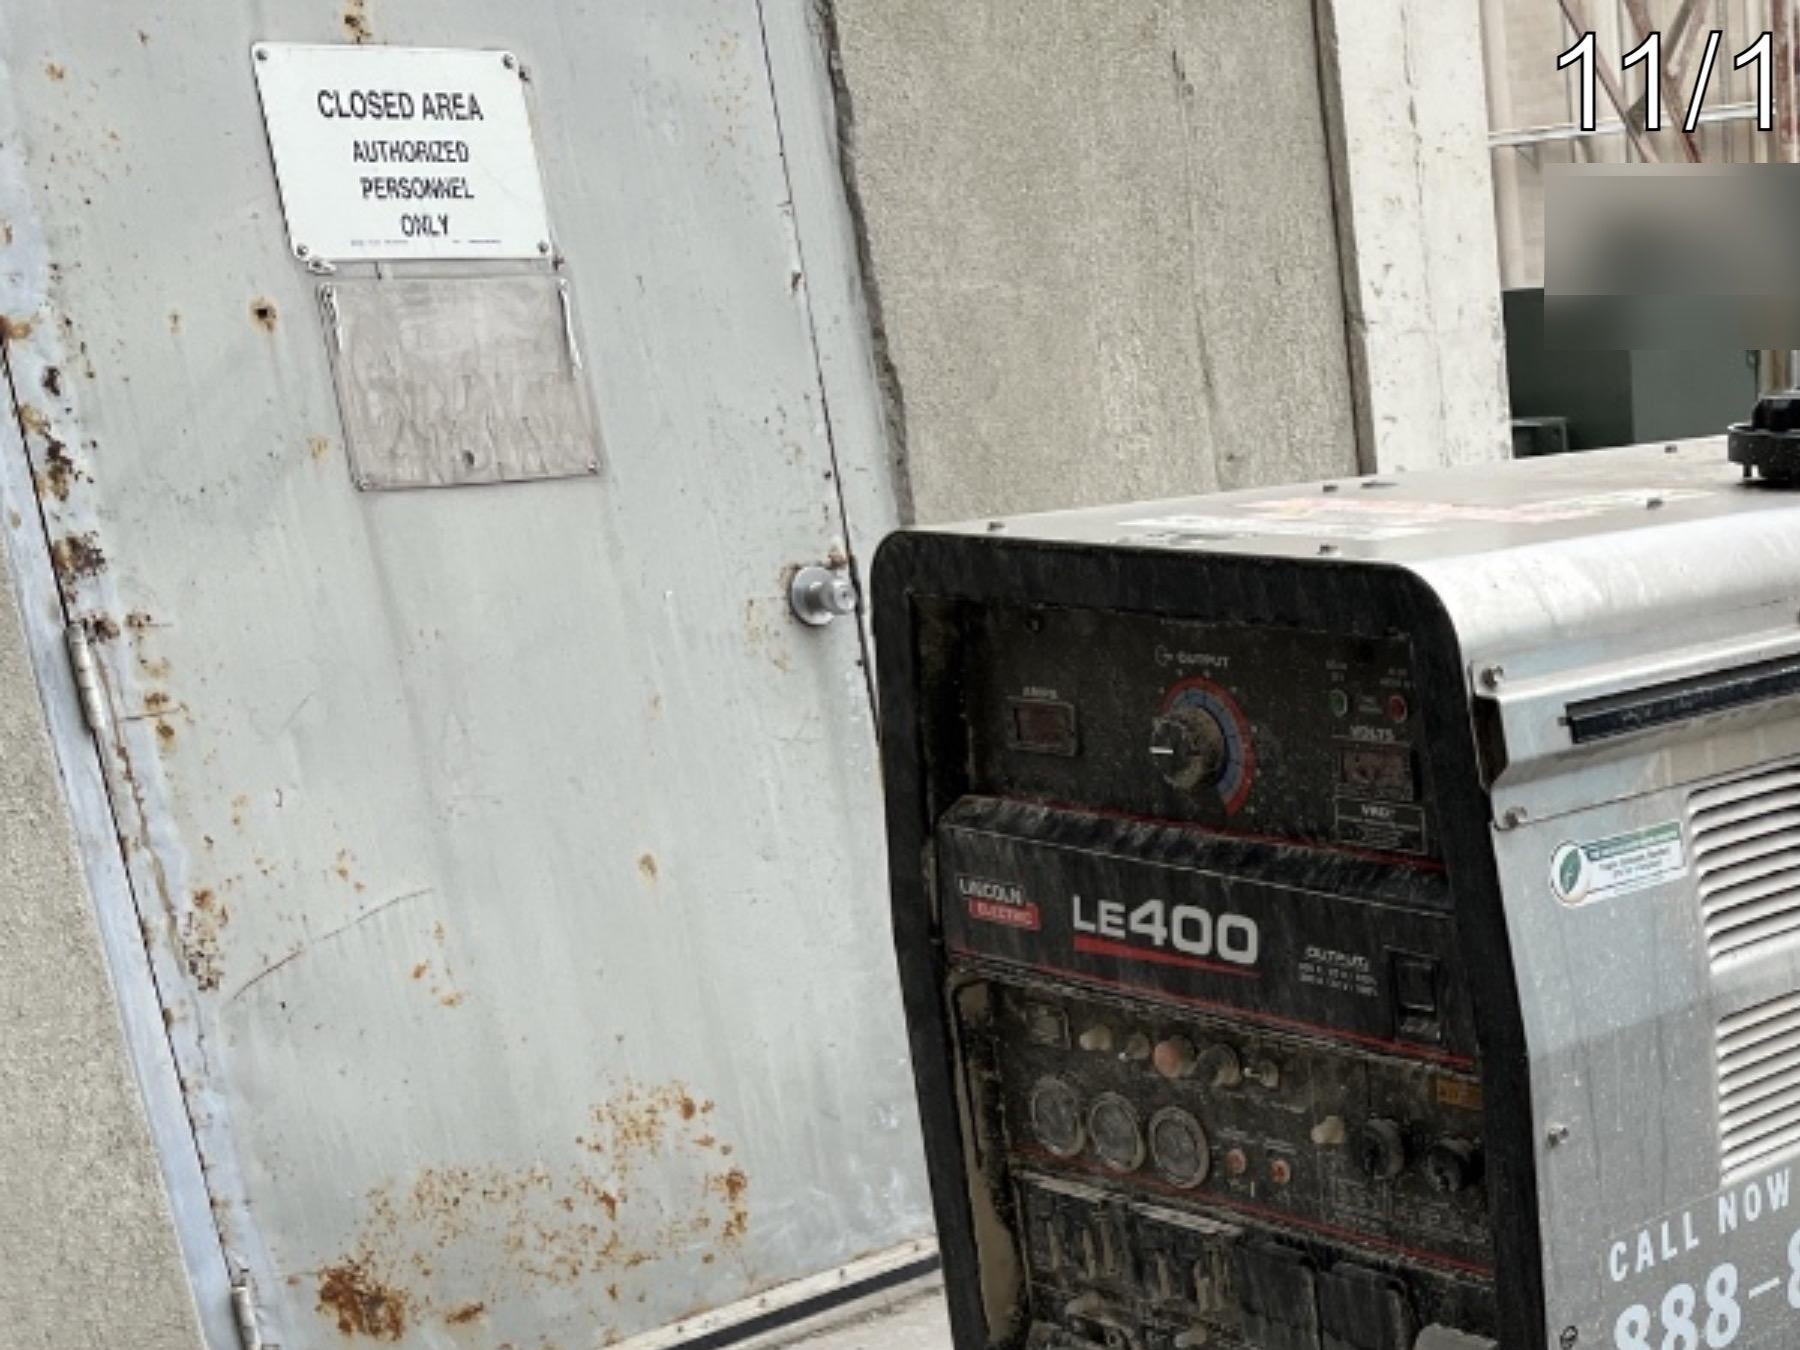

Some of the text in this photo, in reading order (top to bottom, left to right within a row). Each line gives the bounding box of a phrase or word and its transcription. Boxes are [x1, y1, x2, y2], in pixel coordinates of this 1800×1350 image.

[317, 89, 484, 121] CLOSED AREA
[353, 140, 470, 163] AUTHORIZED
[359, 176, 475, 200] PERSONNEL
[400, 212, 449, 237] ONLY
[958, 877, 1023, 905] LINCOLN
[976, 903, 1034, 926] ELECTRIC
[1072, 894, 1260, 965] LE400
[1609, 1167, 1792, 1282] CALL NOW
